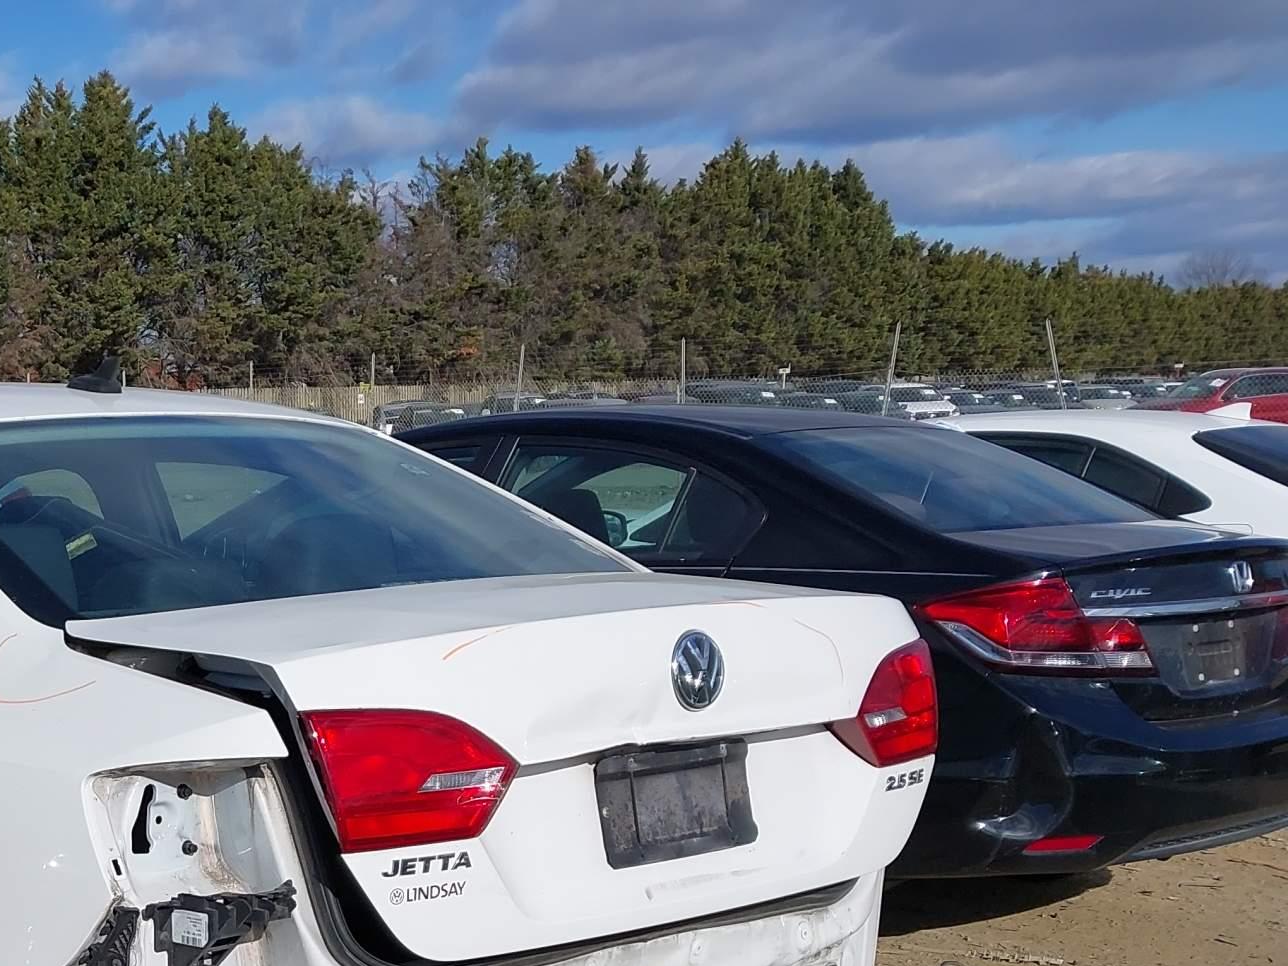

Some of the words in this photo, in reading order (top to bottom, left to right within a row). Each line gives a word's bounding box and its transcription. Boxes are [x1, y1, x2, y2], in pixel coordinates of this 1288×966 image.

[1090, 587, 1152, 599] CIVIC
[907, 768, 925, 786] SE
[381, 851, 472, 877] JETTA
[406, 881, 467, 902] LINDSAY
